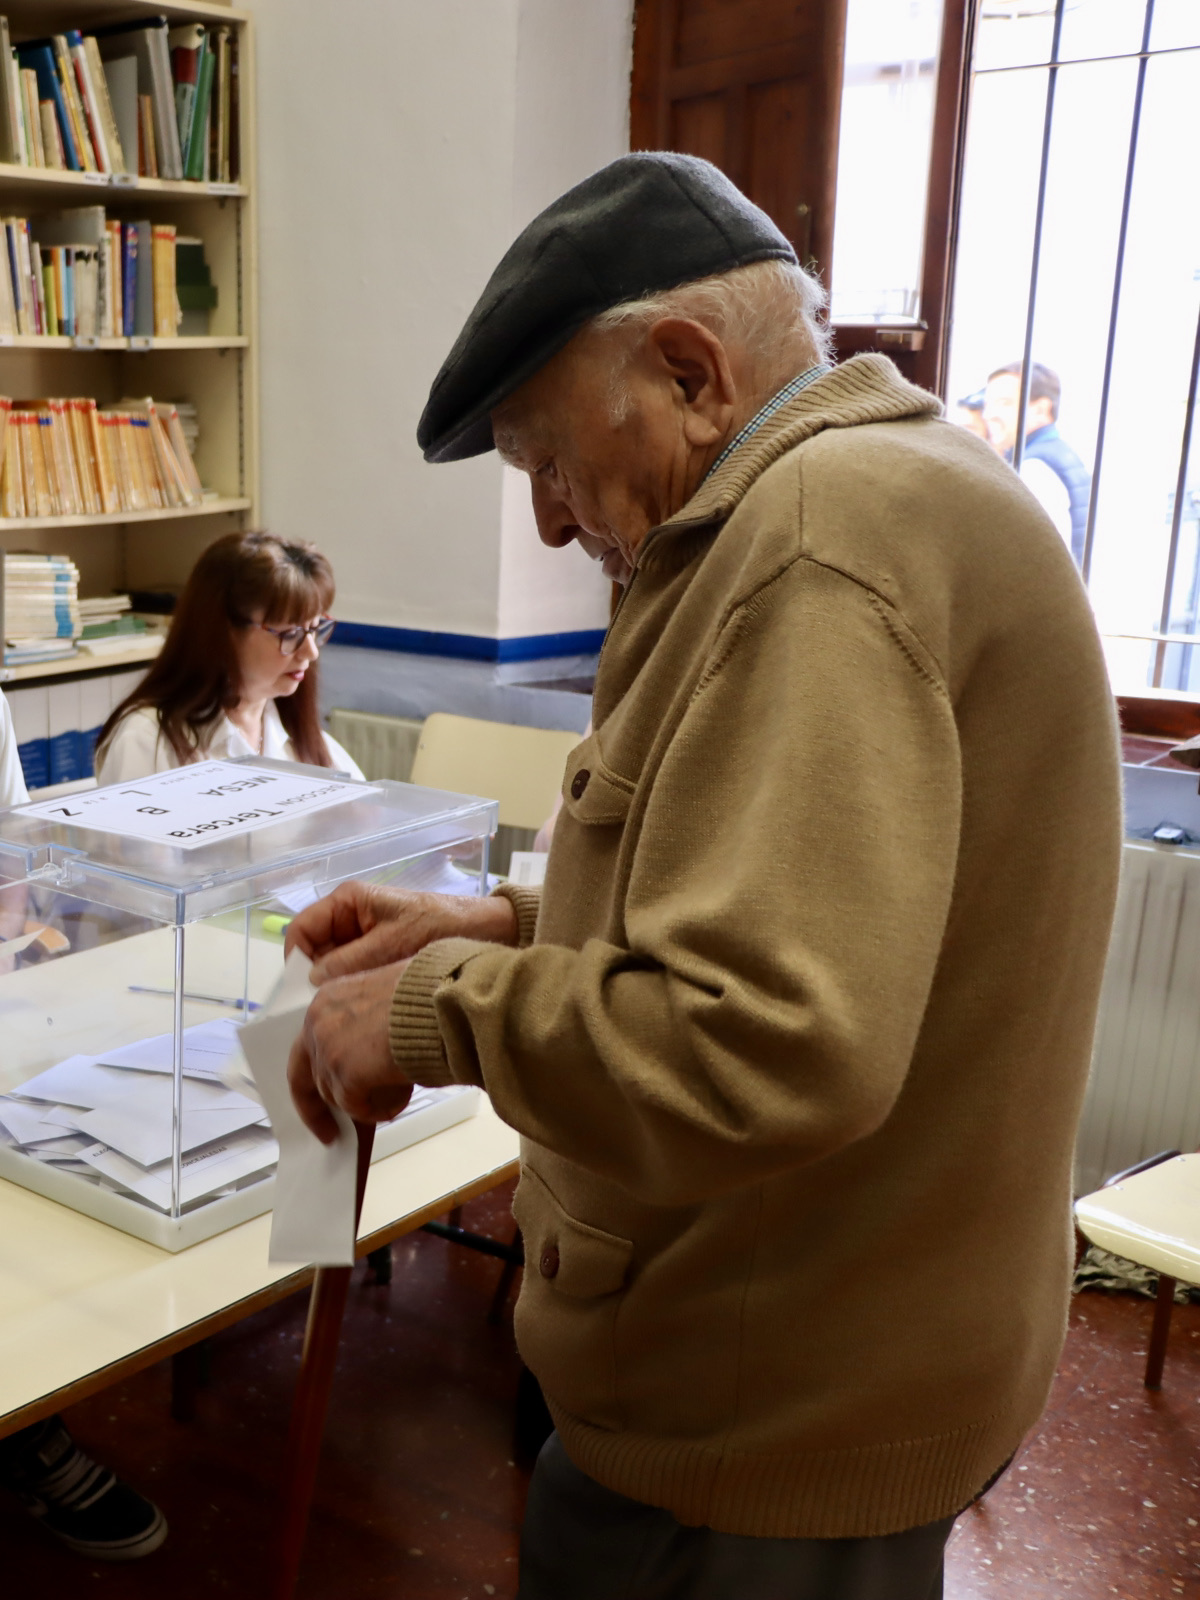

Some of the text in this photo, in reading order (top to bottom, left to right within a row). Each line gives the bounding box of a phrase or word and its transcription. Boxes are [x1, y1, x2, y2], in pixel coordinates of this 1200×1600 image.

[136, 775, 279, 815] MESA B
[47, 807, 83, 818] Z
[166, 808, 285, 838] Tercera
